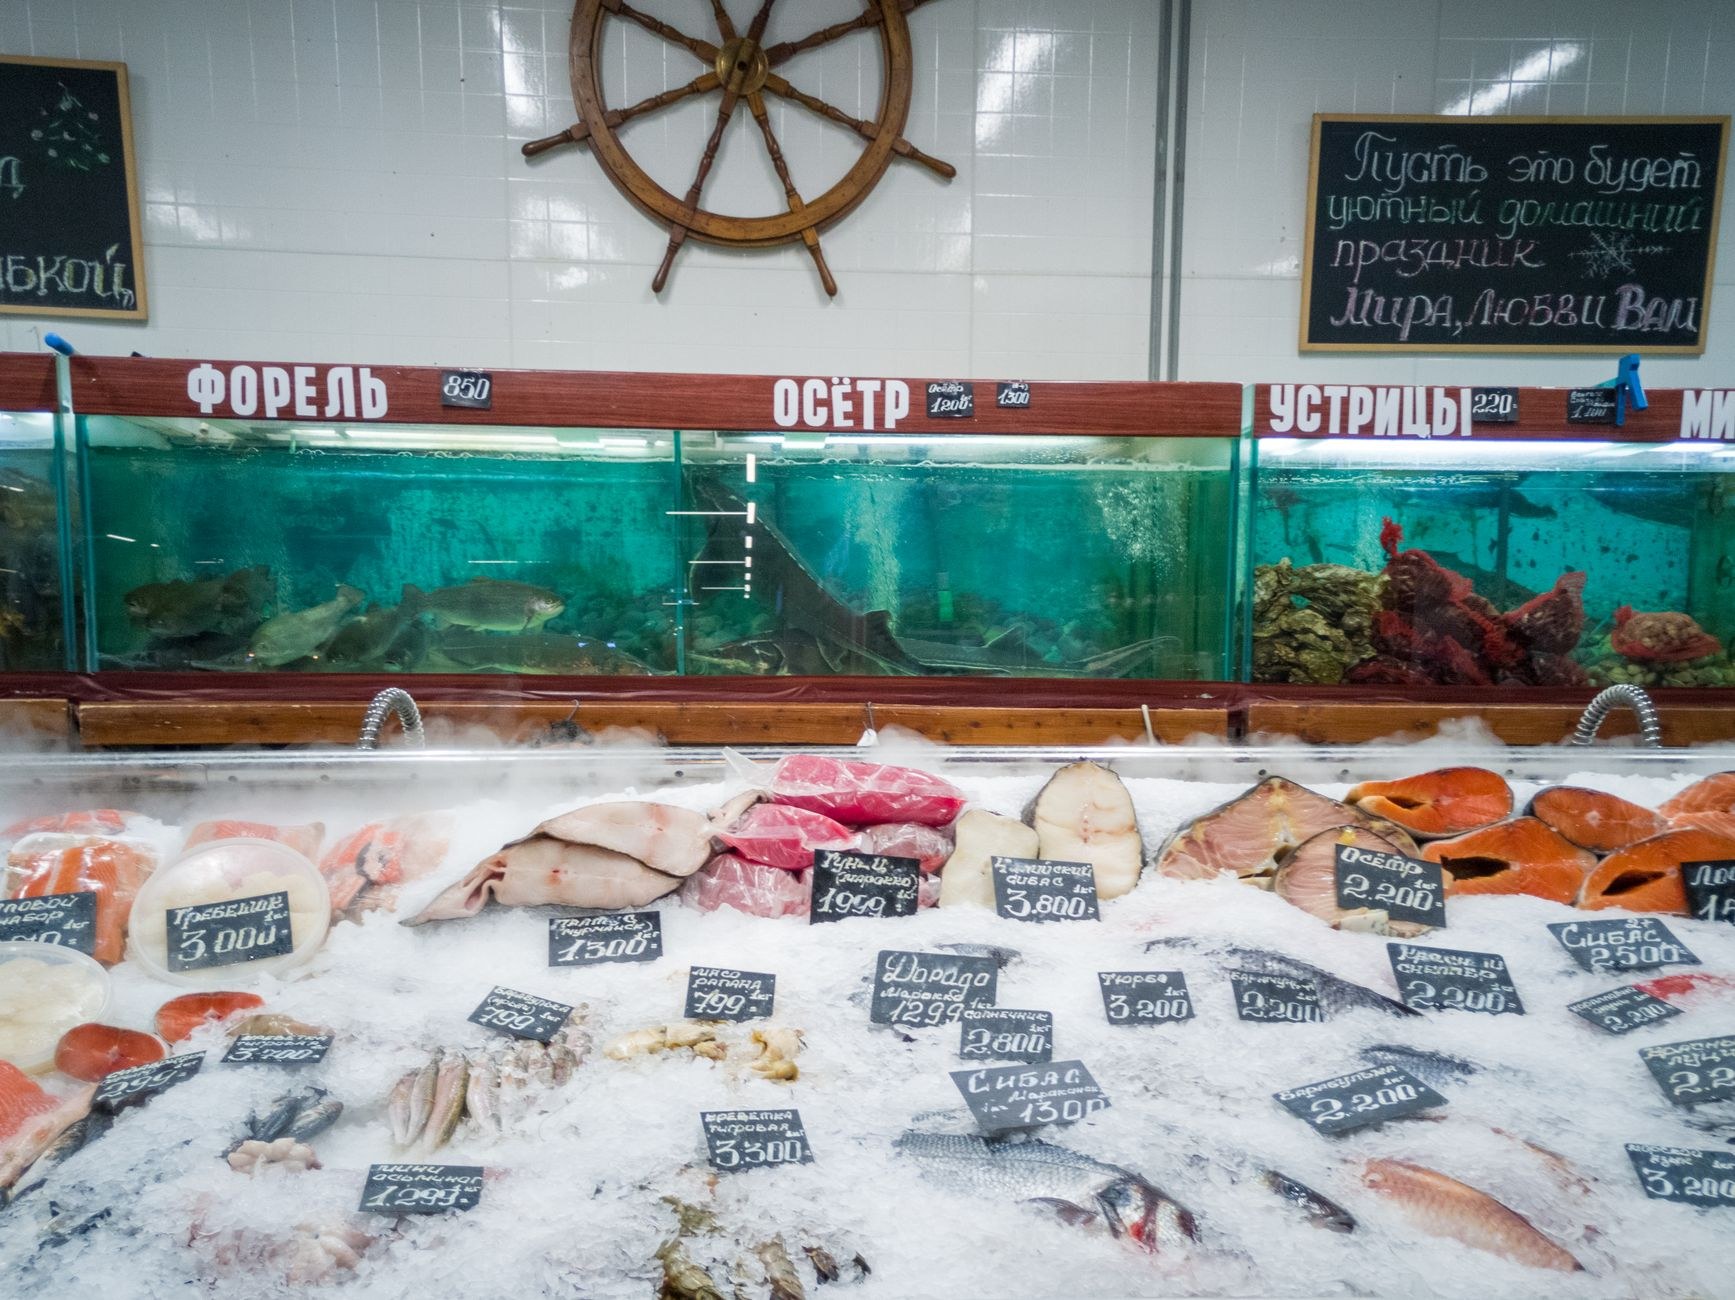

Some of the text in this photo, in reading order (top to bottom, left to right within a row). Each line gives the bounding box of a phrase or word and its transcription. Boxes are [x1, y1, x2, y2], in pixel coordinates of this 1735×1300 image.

[1345, 131, 1701, 194] Пусть это будет
[1328, 190, 1702, 239] уютный домашний
[1330, 240, 1545, 284] праздник
[187, 363, 389, 419] ФОРЕЛЬ
[443, 374, 490, 401] 850
[773, 377, 910, 430] ОСЁТР
[1270, 385, 1472, 439] УСТРИЦЫ
[1680, 390, 1735, 439] МИ
